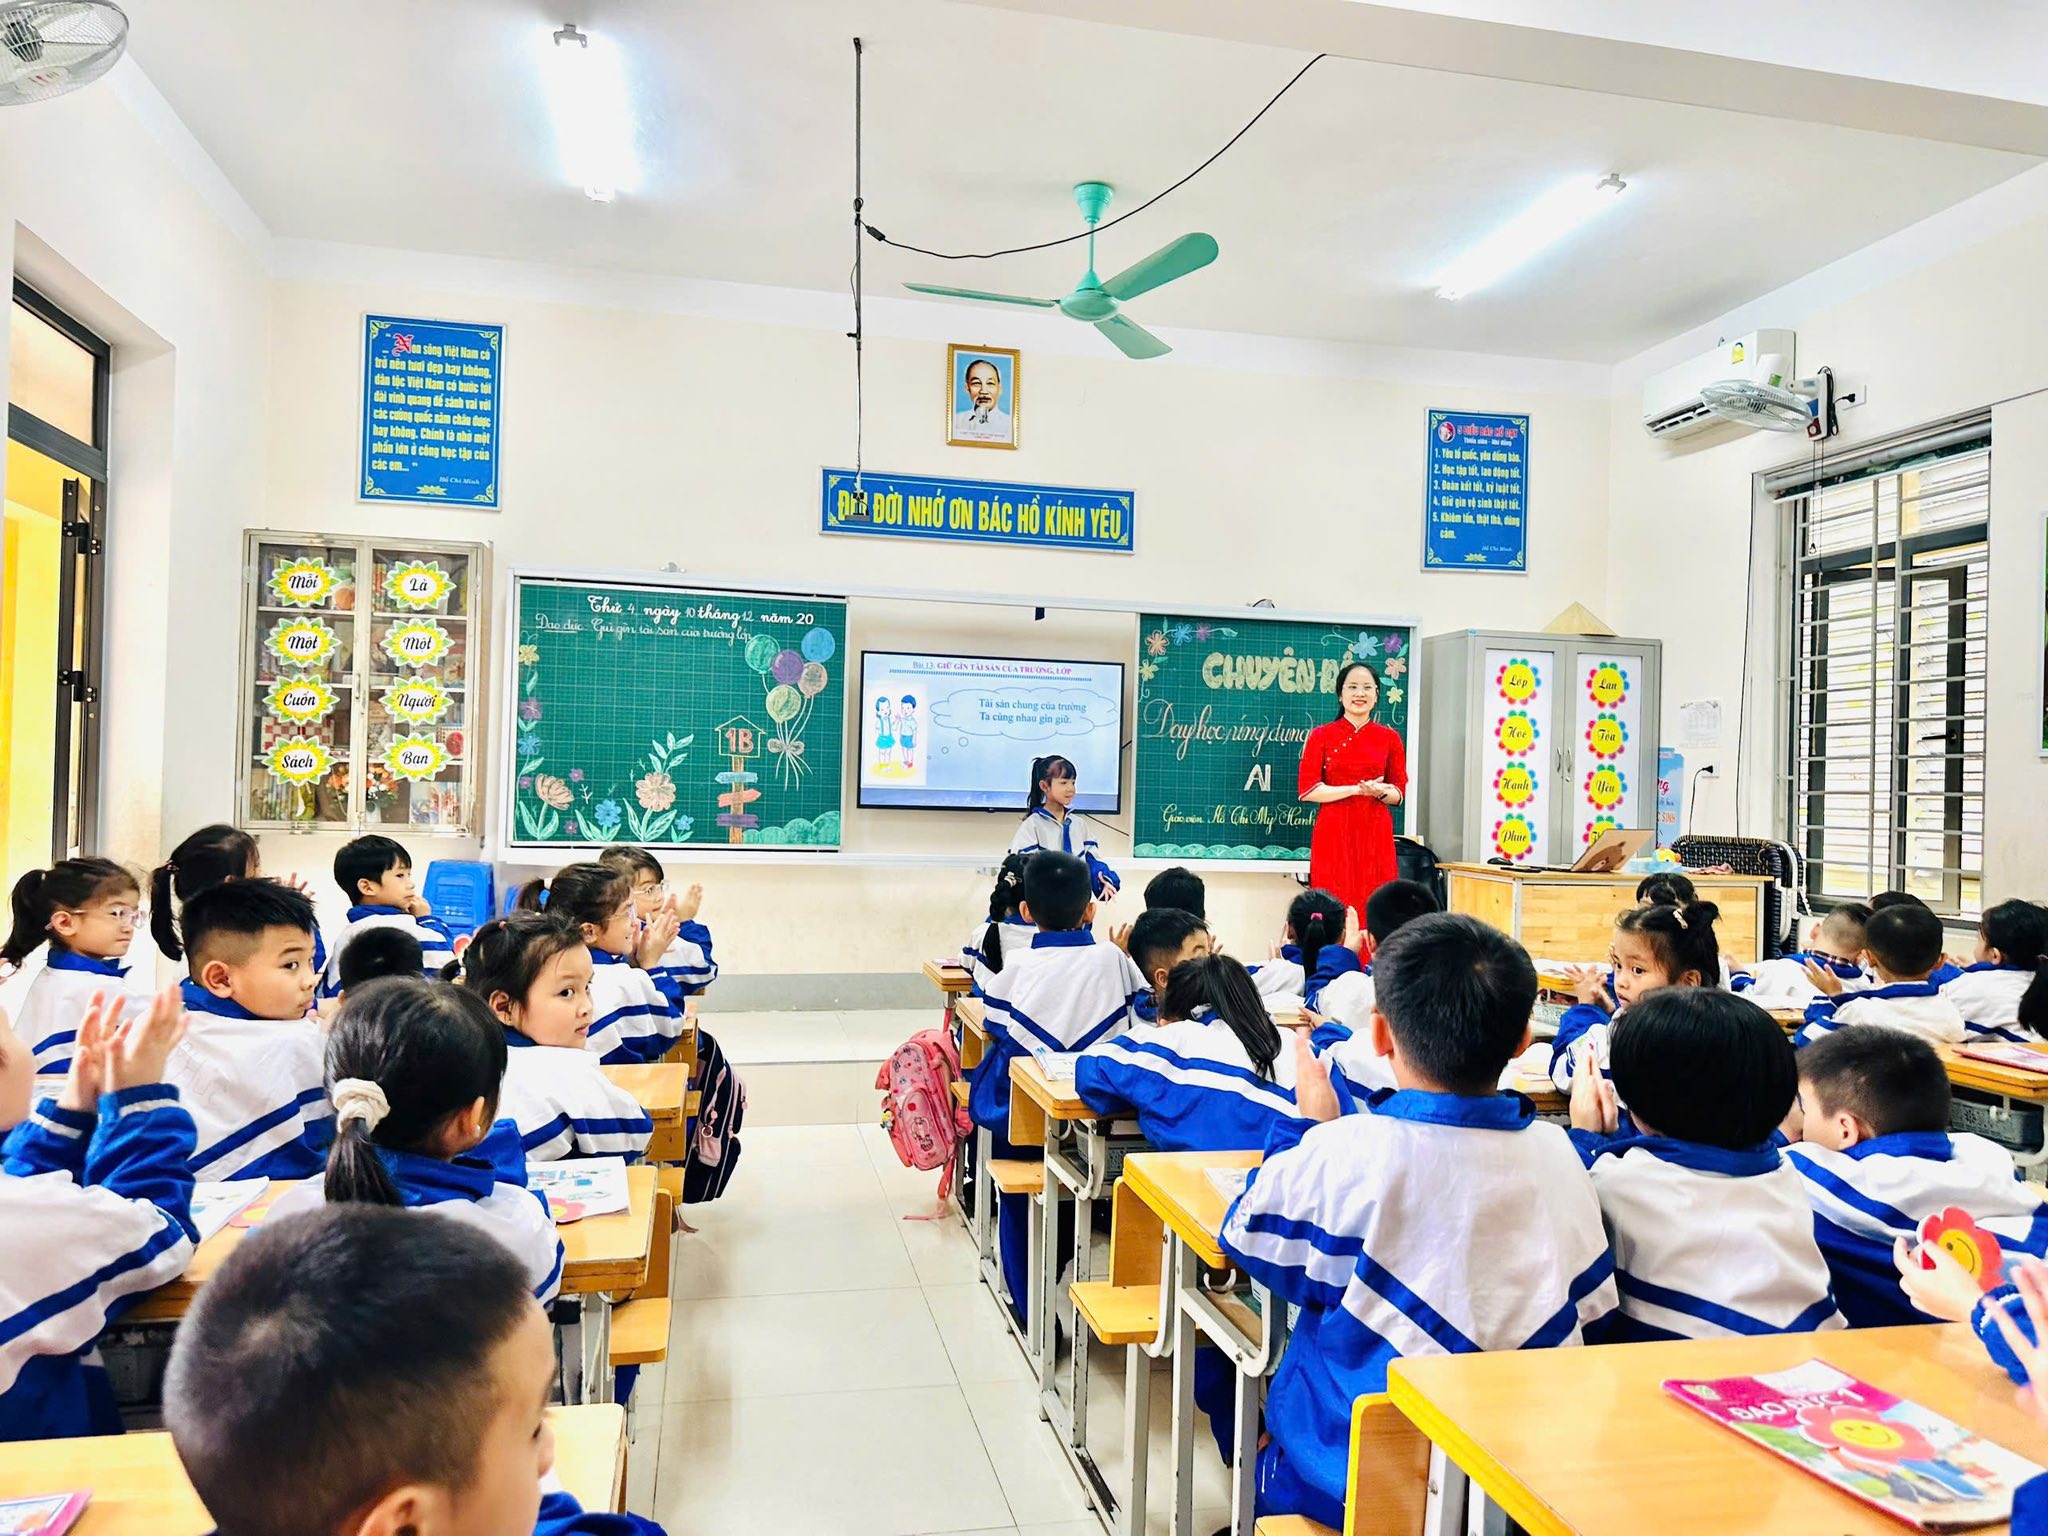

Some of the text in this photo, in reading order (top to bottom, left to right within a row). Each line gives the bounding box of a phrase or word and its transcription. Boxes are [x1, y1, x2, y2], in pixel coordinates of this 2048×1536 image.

[423, 344, 442, 357] sông
[444, 345, 459, 359] Việt
[460, 347, 478, 359] Nam
[480, 349, 490, 360] có
[375, 355, 387, 368] trở
[389, 358, 406, 370] nên
[408, 360, 425, 371] tươi
[427, 361, 443, 375] đẹp
[445, 363, 461, 376] hay
[374, 374, 390, 386] dân
[392, 375, 405, 389] tộc
[407, 376, 423, 390] Việt
[425, 378, 444, 390] Nam
[446, 380, 457, 391] có
[480, 382, 491, 394] tới
[388, 392, 405, 404] vinh
[407, 395, 431, 407] quang
[433, 393, 444, 406] để
[445, 396, 464, 408] sánh
[465, 398, 477, 409] vai
[479, 399, 491, 410] với
[373, 408, 388, 419] các
[389, 408, 412, 422] cường
[414, 409, 433, 423] quốc
[434, 412, 451, 424] năm
[452, 414, 471, 425] châu
[373, 424, 388, 437] hay
[389, 425, 418, 440] không.
[420, 427, 444, 440] Chính
[446, 429, 455, 441] là
[474, 432, 490, 446] một
[395, 442, 409, 454] lớn
[418, 444, 439, 458] công
[441, 446, 457, 460] học
[459, 447, 472, 461] tập
[474, 447, 489, 460] của
[1434, 448, 1440, 458] 1.
[1442, 448, 1453, 458] Yêu
[1480, 450, 1491, 461] yêu
[1492, 449, 1507, 463] đồng
[372, 458, 387, 470] các
[1433, 463, 1440, 474] 2.
[1442, 464, 1455, 476] Học
[1456, 464, 1467, 477] tập
[1481, 466, 1492, 476] lao
[1493, 467, 1509, 479] động
[1433, 480, 1440, 490] 3.
[1433, 495, 1440, 506] 4.
[1477, 498, 1493, 509] sinh
[873, 485, 1121, 540] ĐỜI NHỚ ƠN BÁC HỒ KÍNH YÊU
[1432, 512, 1439, 522] 5.
[1441, 511, 1461, 523] Khiêm
[288, 573, 319, 589] Mỗi
[409, 577, 427, 592] Là
[587, 595, 814, 628] Thứ 4 ngày 10 tháng 12 năm 20
[287, 635, 318, 652] Một
[403, 636, 433, 652] Một
[937, 661, 952, 670] GIỮ
[954, 662, 968, 670] GÌN
[970, 663, 983, 671] TÀI
[1002, 664, 1018, 672] CỦA
[1056, 666, 1072, 675] LỚP
[1202, 646, 1316, 693] CHUYÊN
[1598, 678, 1617, 690] Lan
[283, 690, 316, 707] Cuốn
[397, 694, 437, 711] Người
[979, 698, 1087, 714] Tài sản chung của trường
[980, 711, 1072, 725] Ta cùng nhau gìn giữ.
[1143, 699, 1313, 761] Dạy học ứng dụng
[725, 727, 754, 753] 1B
[282, 754, 313, 769] Sách
[402, 751, 428, 766] Bạn
[1244, 764, 1271, 792] AI
[1728, 1387, 1865, 1421] ĐẠO 1
